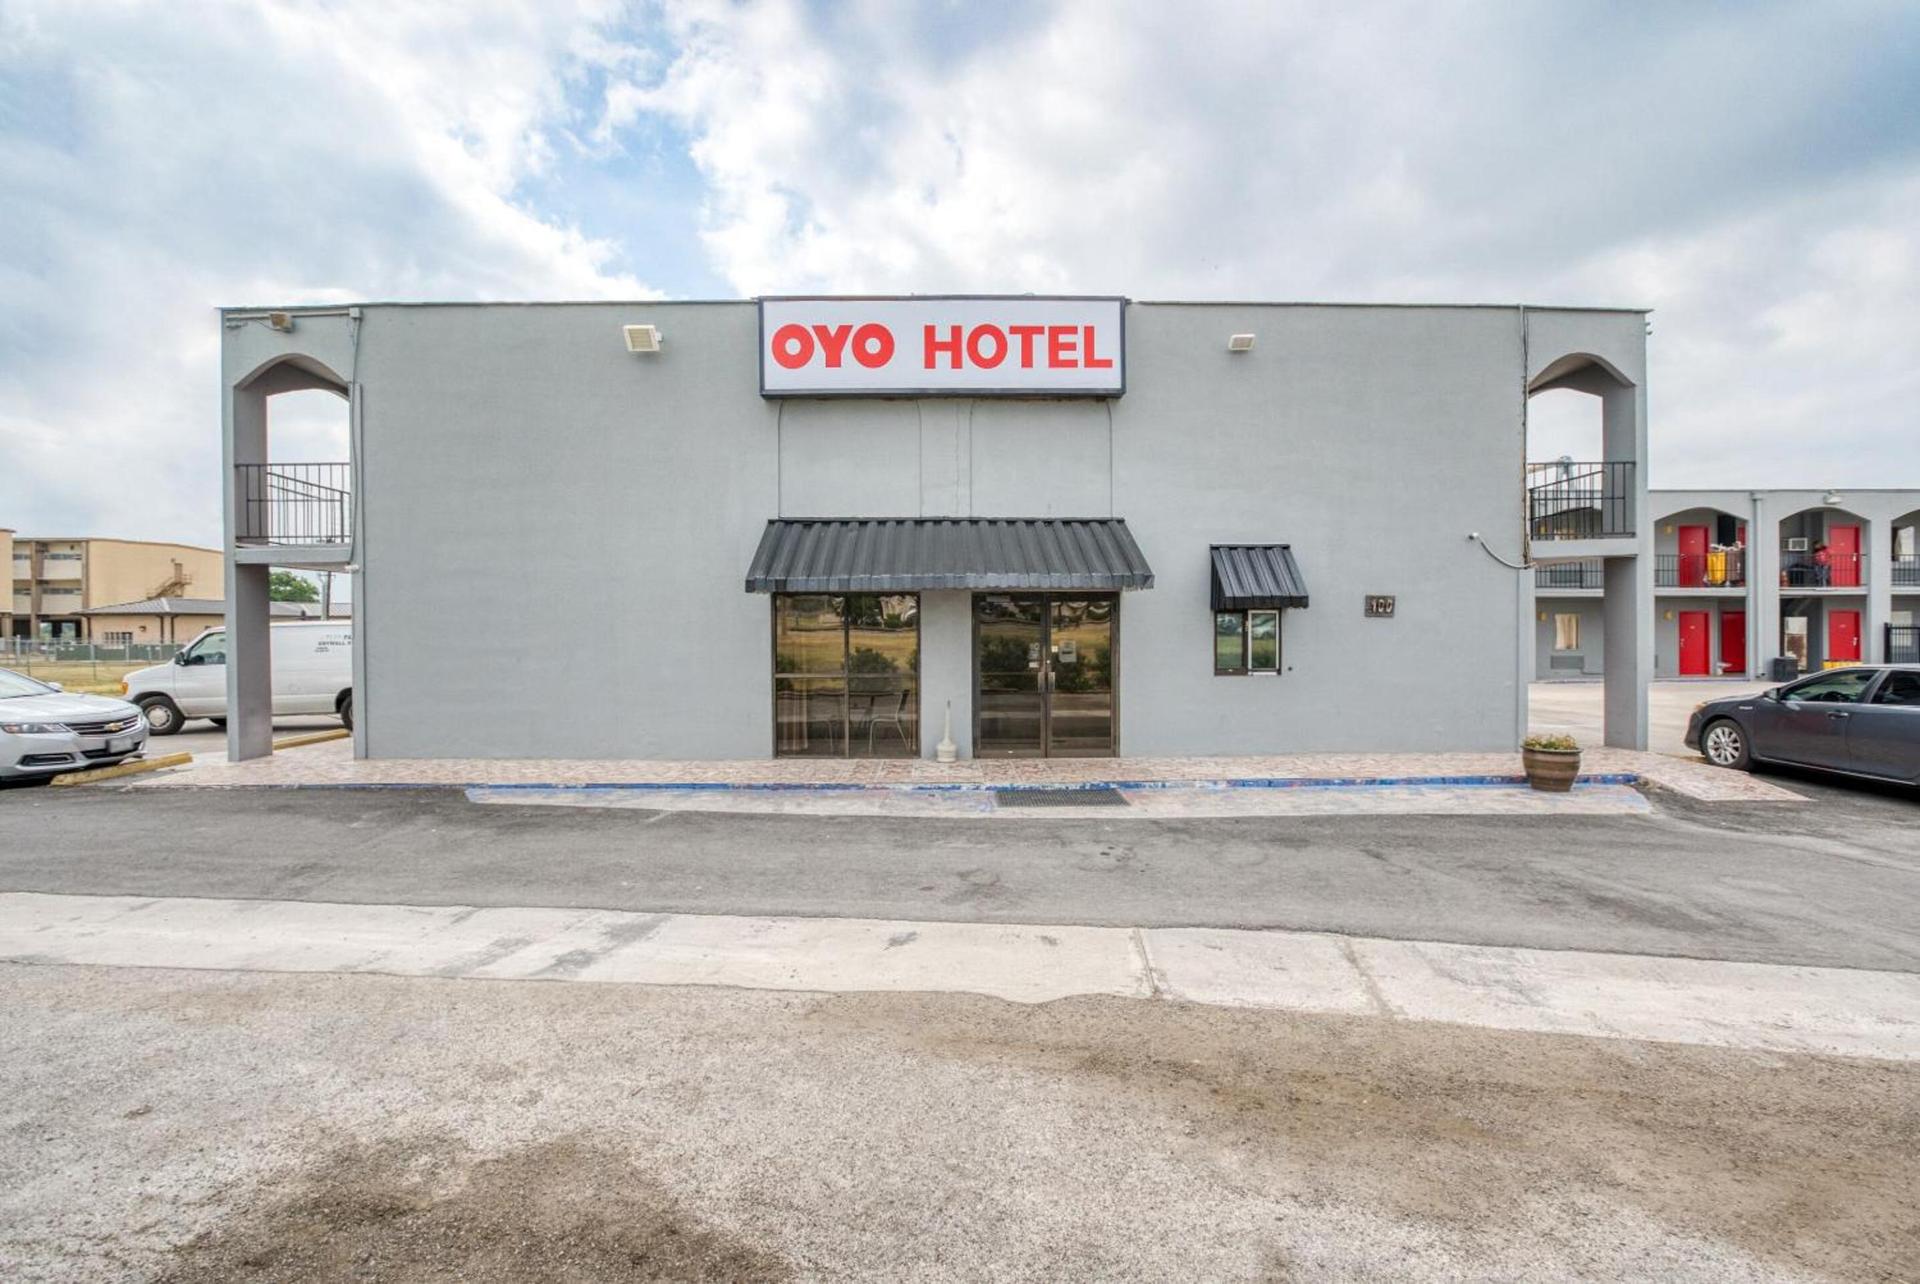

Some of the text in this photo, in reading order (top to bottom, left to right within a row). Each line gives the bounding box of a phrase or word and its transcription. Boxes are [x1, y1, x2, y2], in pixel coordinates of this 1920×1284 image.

[772, 323, 1113, 369] OYO HOTEL
[1371, 598, 1393, 613] 100
